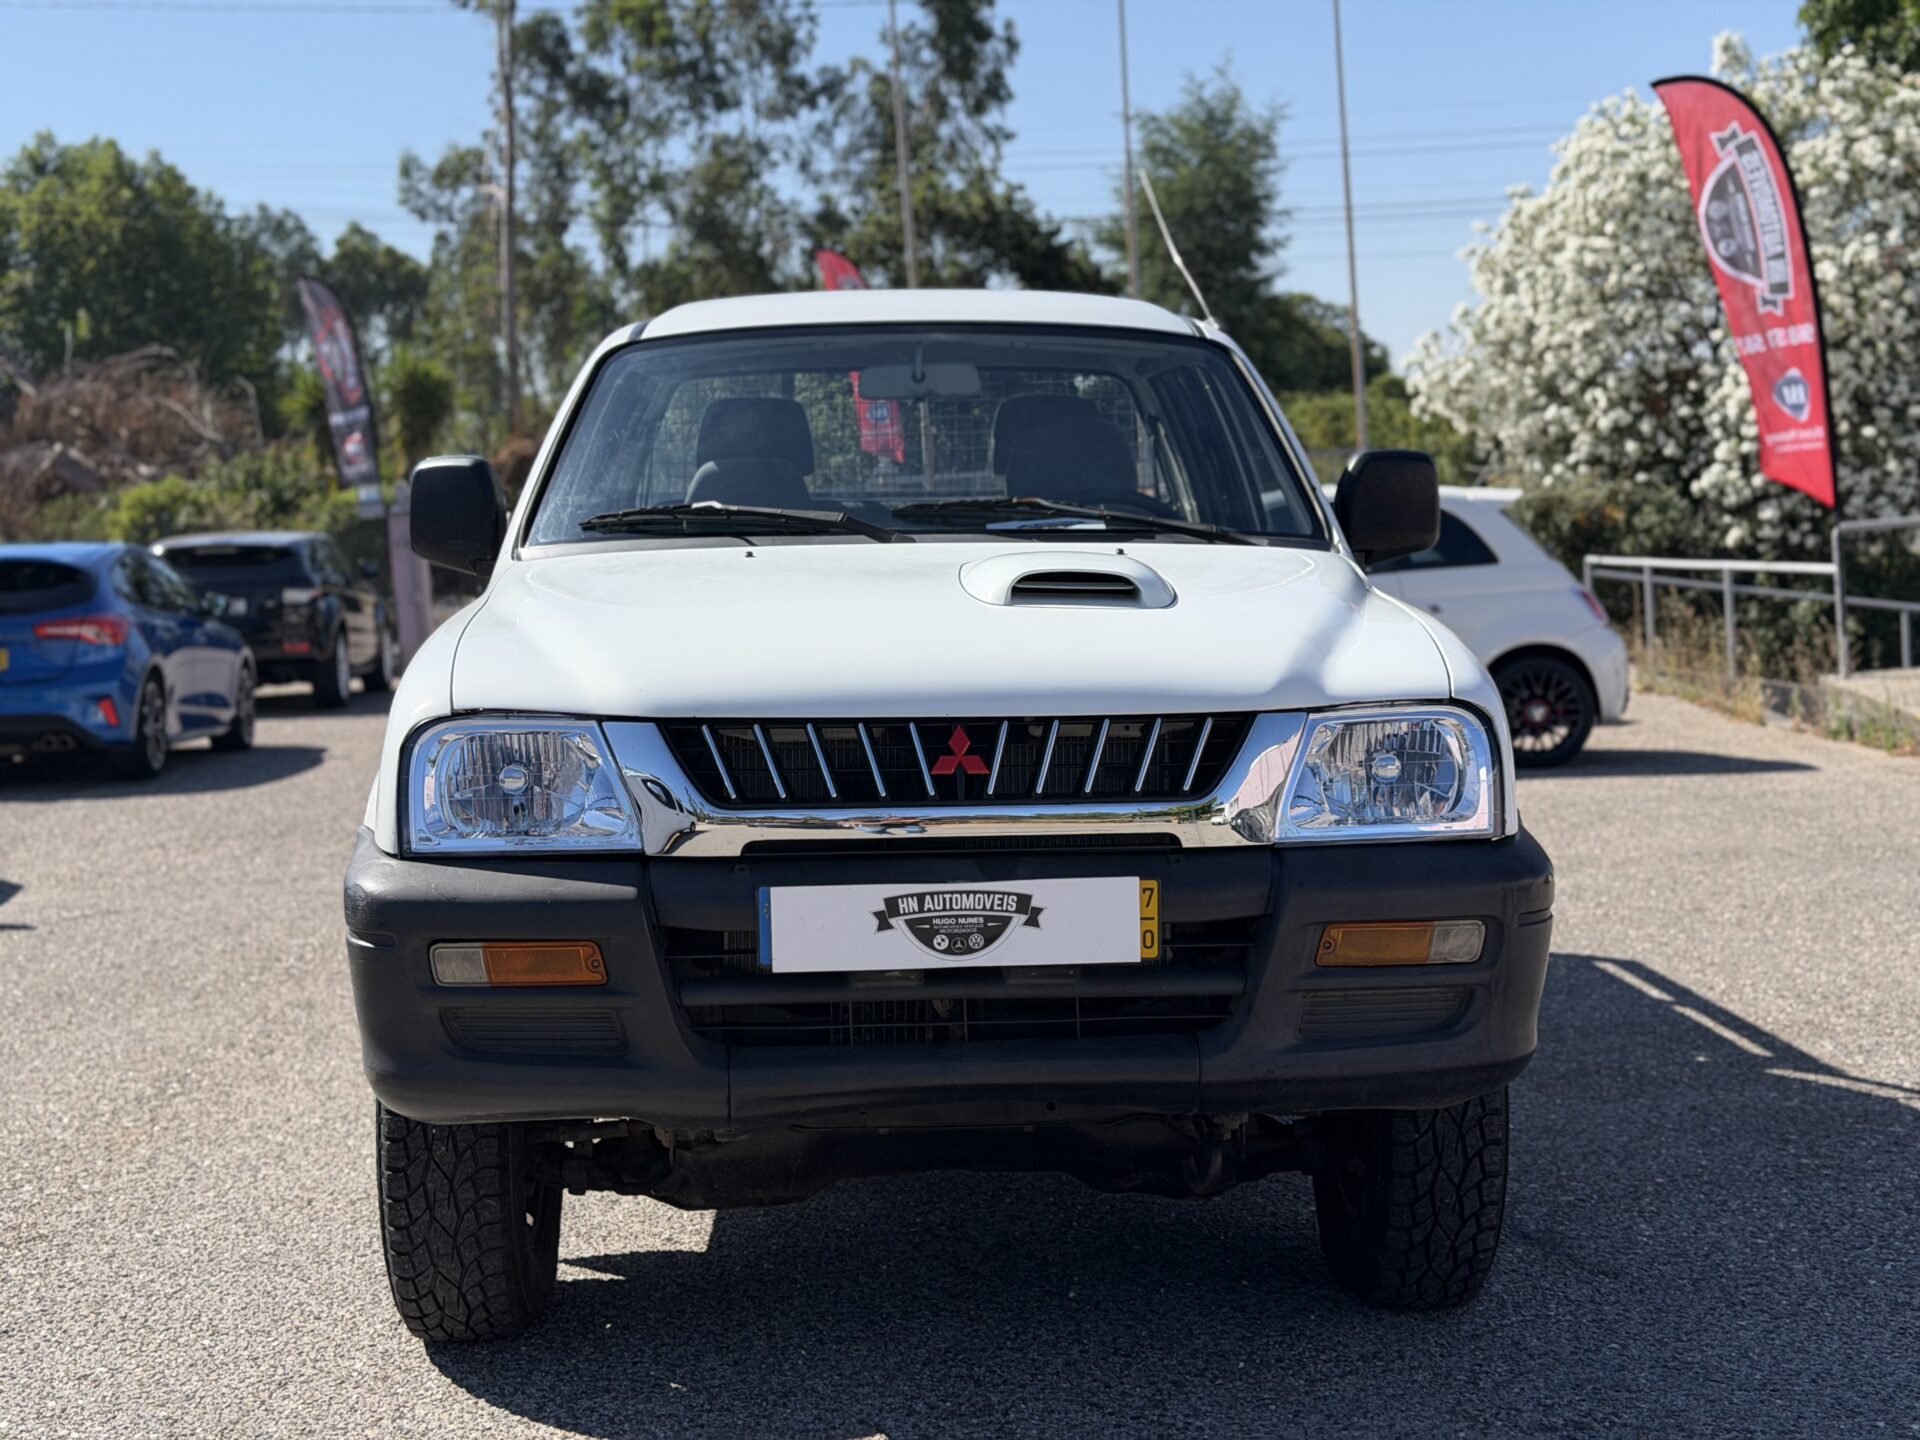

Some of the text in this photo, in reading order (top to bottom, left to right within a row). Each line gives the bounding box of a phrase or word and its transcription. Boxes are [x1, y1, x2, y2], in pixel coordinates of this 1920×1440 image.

[897, 893, 1018, 914] HN AUTOMOVEIS
[932, 916, 984, 925] HUGO NUNES
